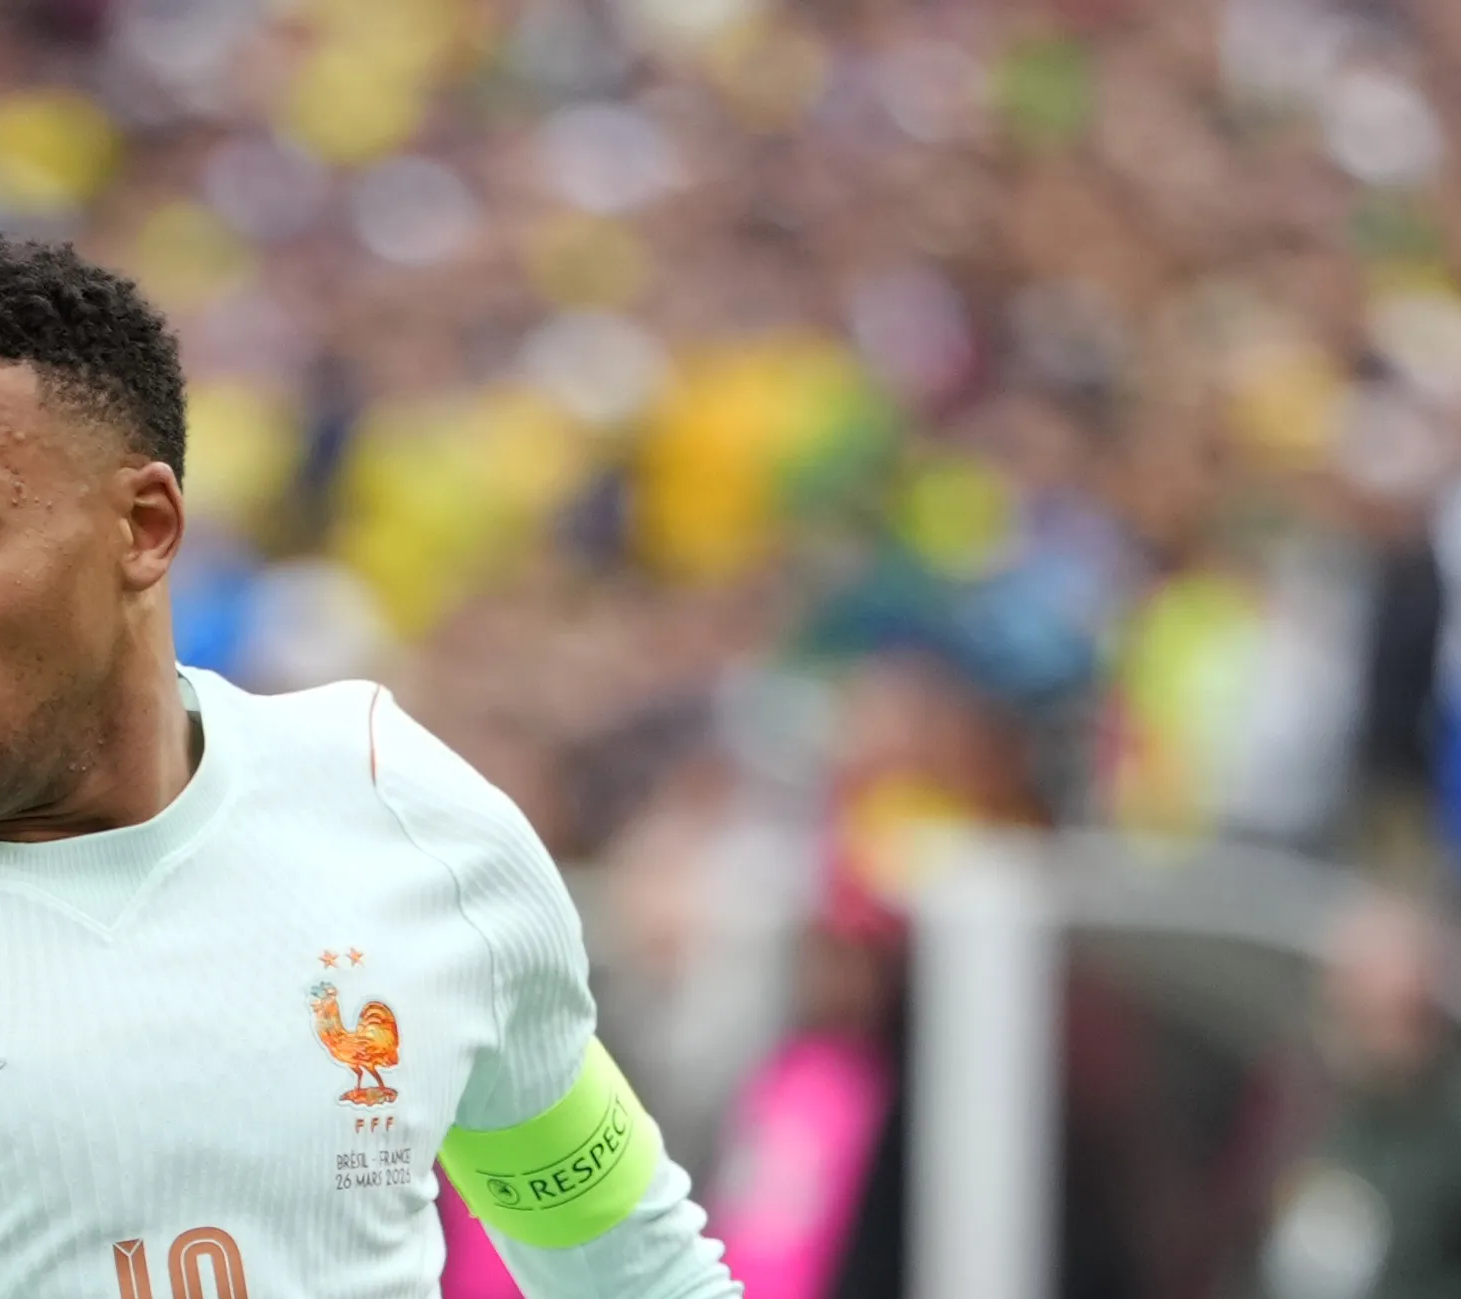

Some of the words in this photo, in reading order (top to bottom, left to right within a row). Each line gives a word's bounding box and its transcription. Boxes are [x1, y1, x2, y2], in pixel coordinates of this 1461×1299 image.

[528, 1091, 628, 1201] RESPECT
[379, 1148, 411, 1167] FRANCE
[335, 1172, 352, 1190] 26
[356, 1170, 383, 1187] MARS
